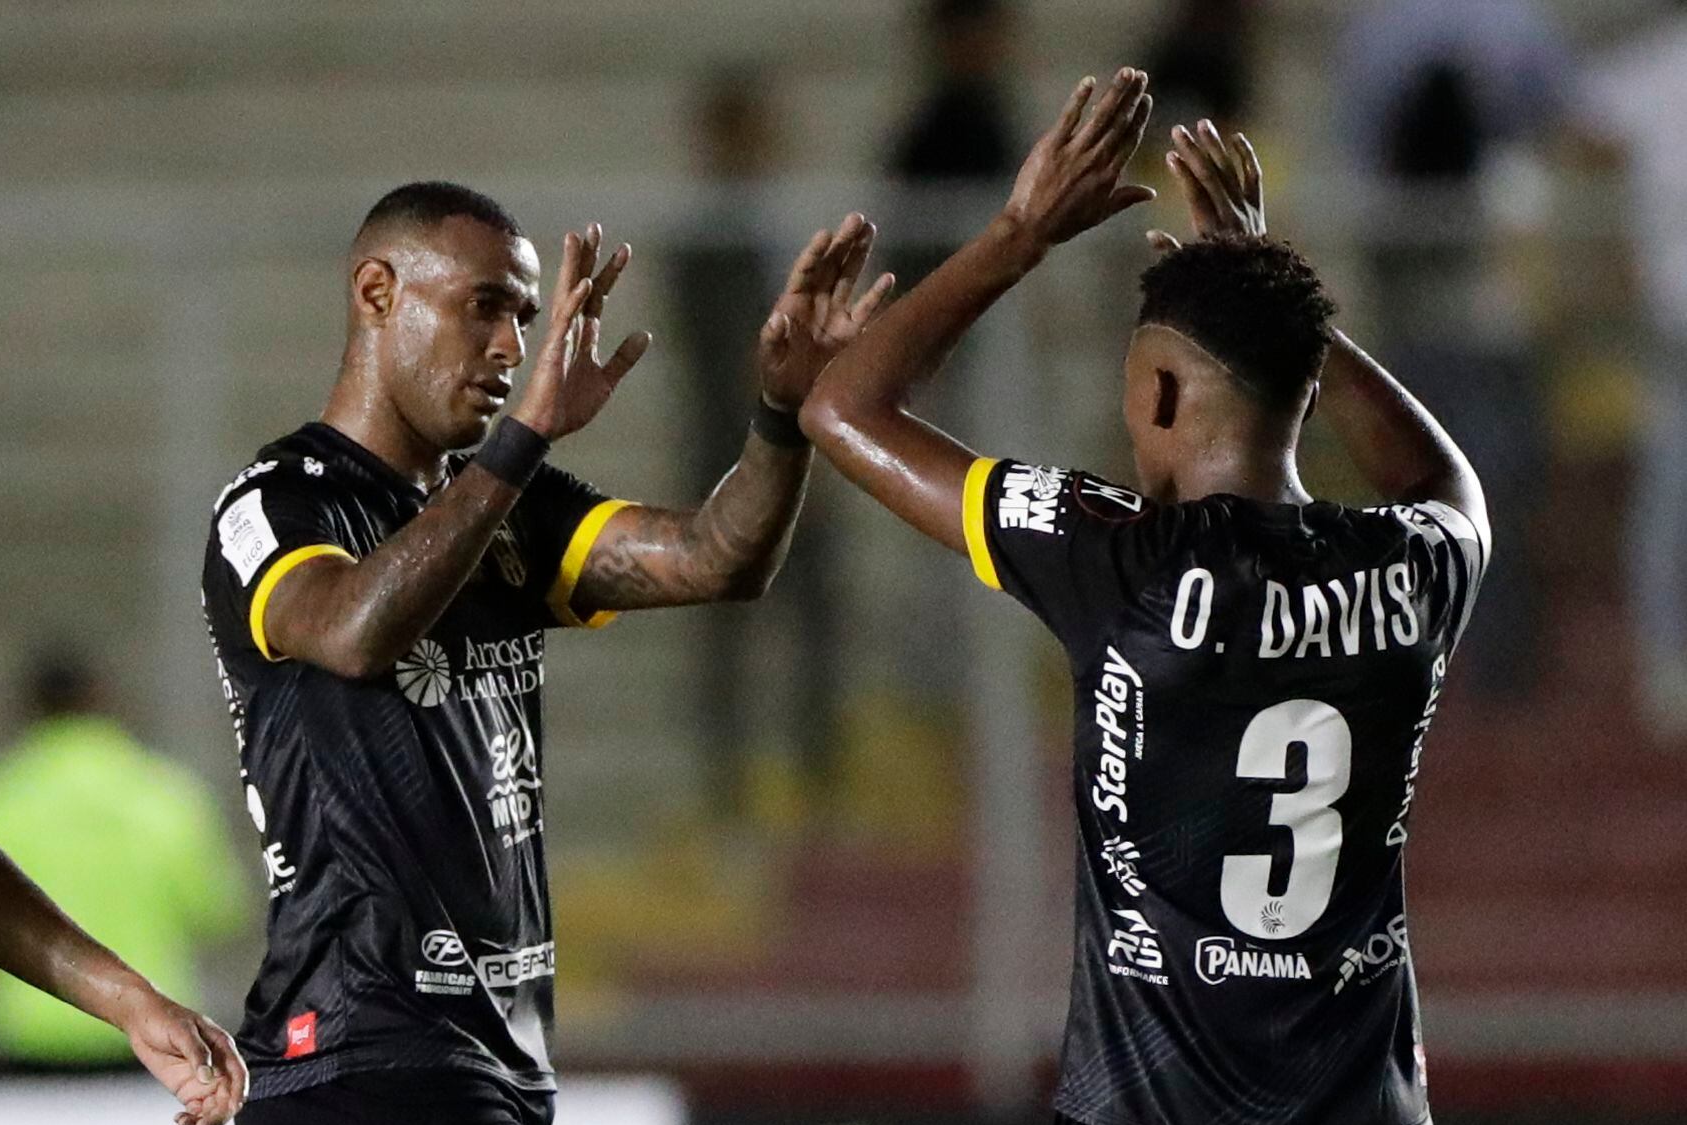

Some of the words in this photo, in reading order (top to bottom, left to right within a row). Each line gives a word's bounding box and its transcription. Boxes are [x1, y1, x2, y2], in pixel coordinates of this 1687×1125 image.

[1170, 567, 1225, 653] O.
[1258, 562, 1419, 659] DAVIS
[1093, 645, 1143, 823] StarPlay
[1220, 698, 1352, 941] 3
